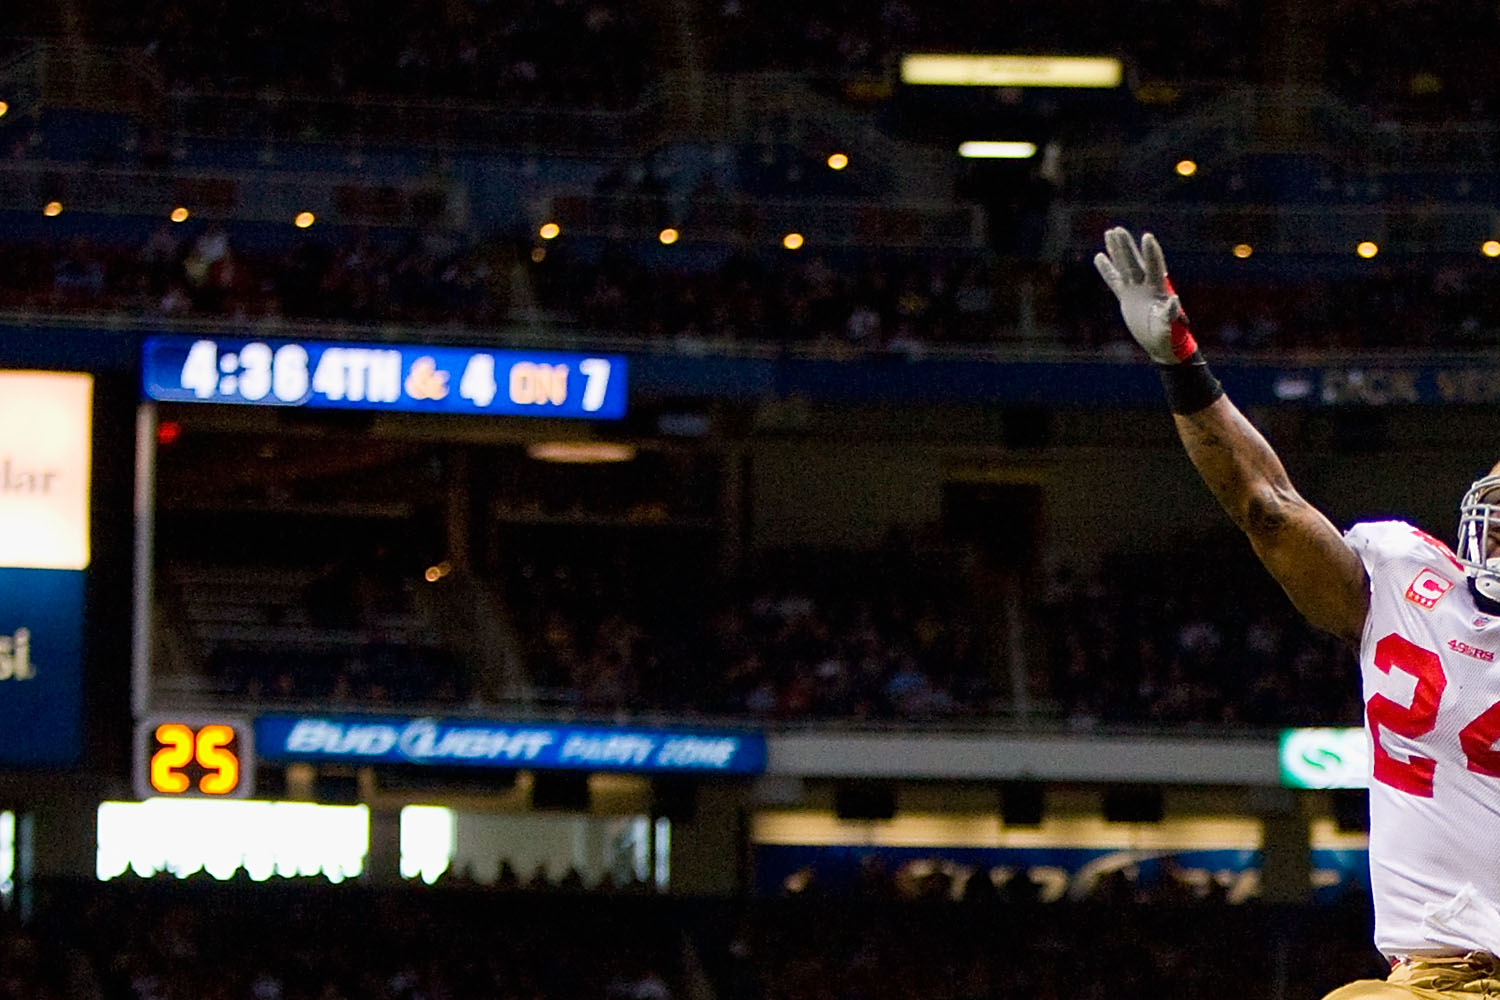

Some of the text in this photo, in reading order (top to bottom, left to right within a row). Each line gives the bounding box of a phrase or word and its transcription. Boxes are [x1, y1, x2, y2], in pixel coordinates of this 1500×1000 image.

[312, 347, 402, 403] 4TH
[404, 356, 451, 400] &
[459, 353, 497, 408] 4
[509, 361, 570, 405] ON
[1412, 571, 1450, 600] C
[1447, 639, 1495, 663] 49ERS
[286, 719, 397, 755] BUD
[150, 723, 239, 795] 25
